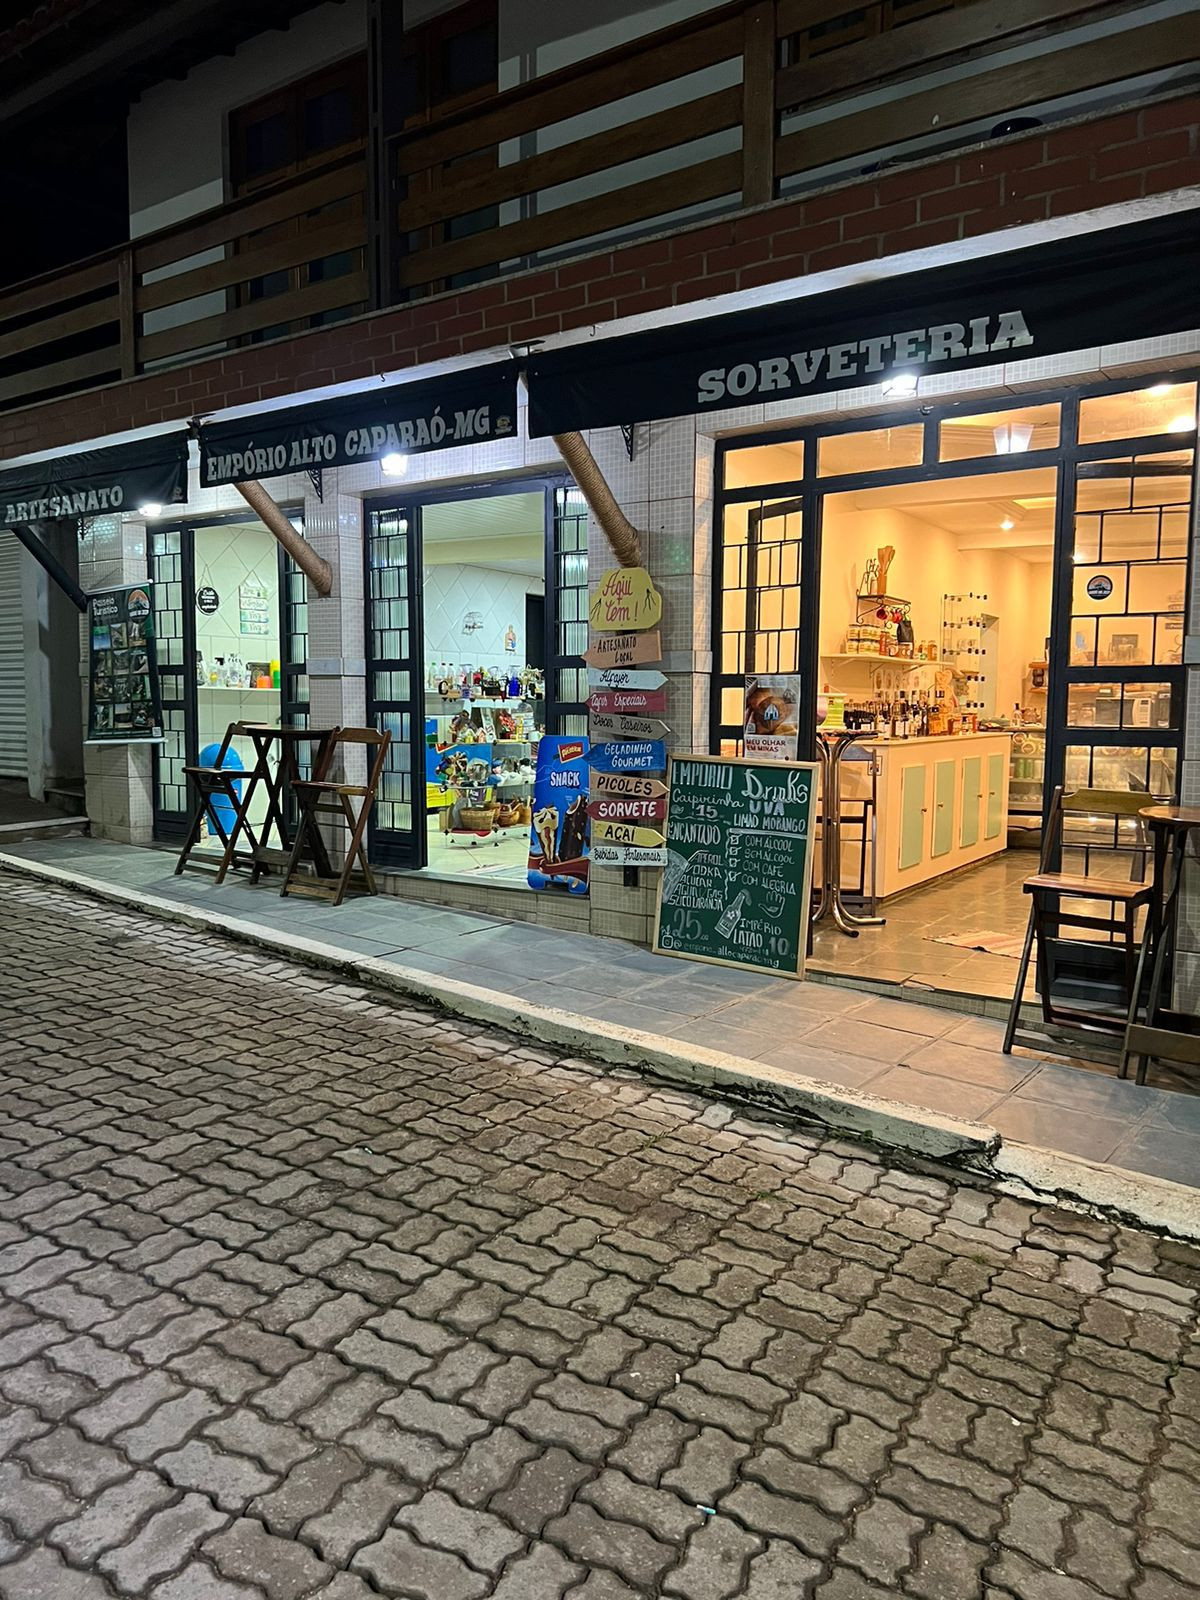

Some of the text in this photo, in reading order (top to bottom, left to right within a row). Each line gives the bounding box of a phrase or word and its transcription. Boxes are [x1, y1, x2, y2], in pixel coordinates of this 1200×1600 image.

[697, 310, 1035, 403] SORVETERIA
[207, 406, 491, 481] EMPÓRIO ALTO CAPARAÓ-MG
[4, 485, 124, 523] ARTESANATO
[602, 569, 633, 605] Aqui
[597, 635, 637, 653] ARTESANATO
[620, 716, 653, 733] Caseiros
[604, 743, 653, 756] GELADINHO
[612, 755, 653, 768] GOURMET
[550, 771, 580, 787] SNACK
[597, 776, 653, 796] PICOLÉS
[672, 788, 744, 809] Caipirinha
[598, 801, 657, 818] SORVETE
[749, 799, 785, 816] UVA
[604, 824, 636, 842] AÇAÍ
[762, 816, 806, 833] MORANGO
[745, 835, 762, 847] COM
[594, 845, 619, 861] Bebidas
[685, 863, 722, 879] VODKA
[742, 860, 784, 877] COM CAFÉ
[741, 874, 758, 886] COM
[740, 918, 782, 936] IMPÉRIO
